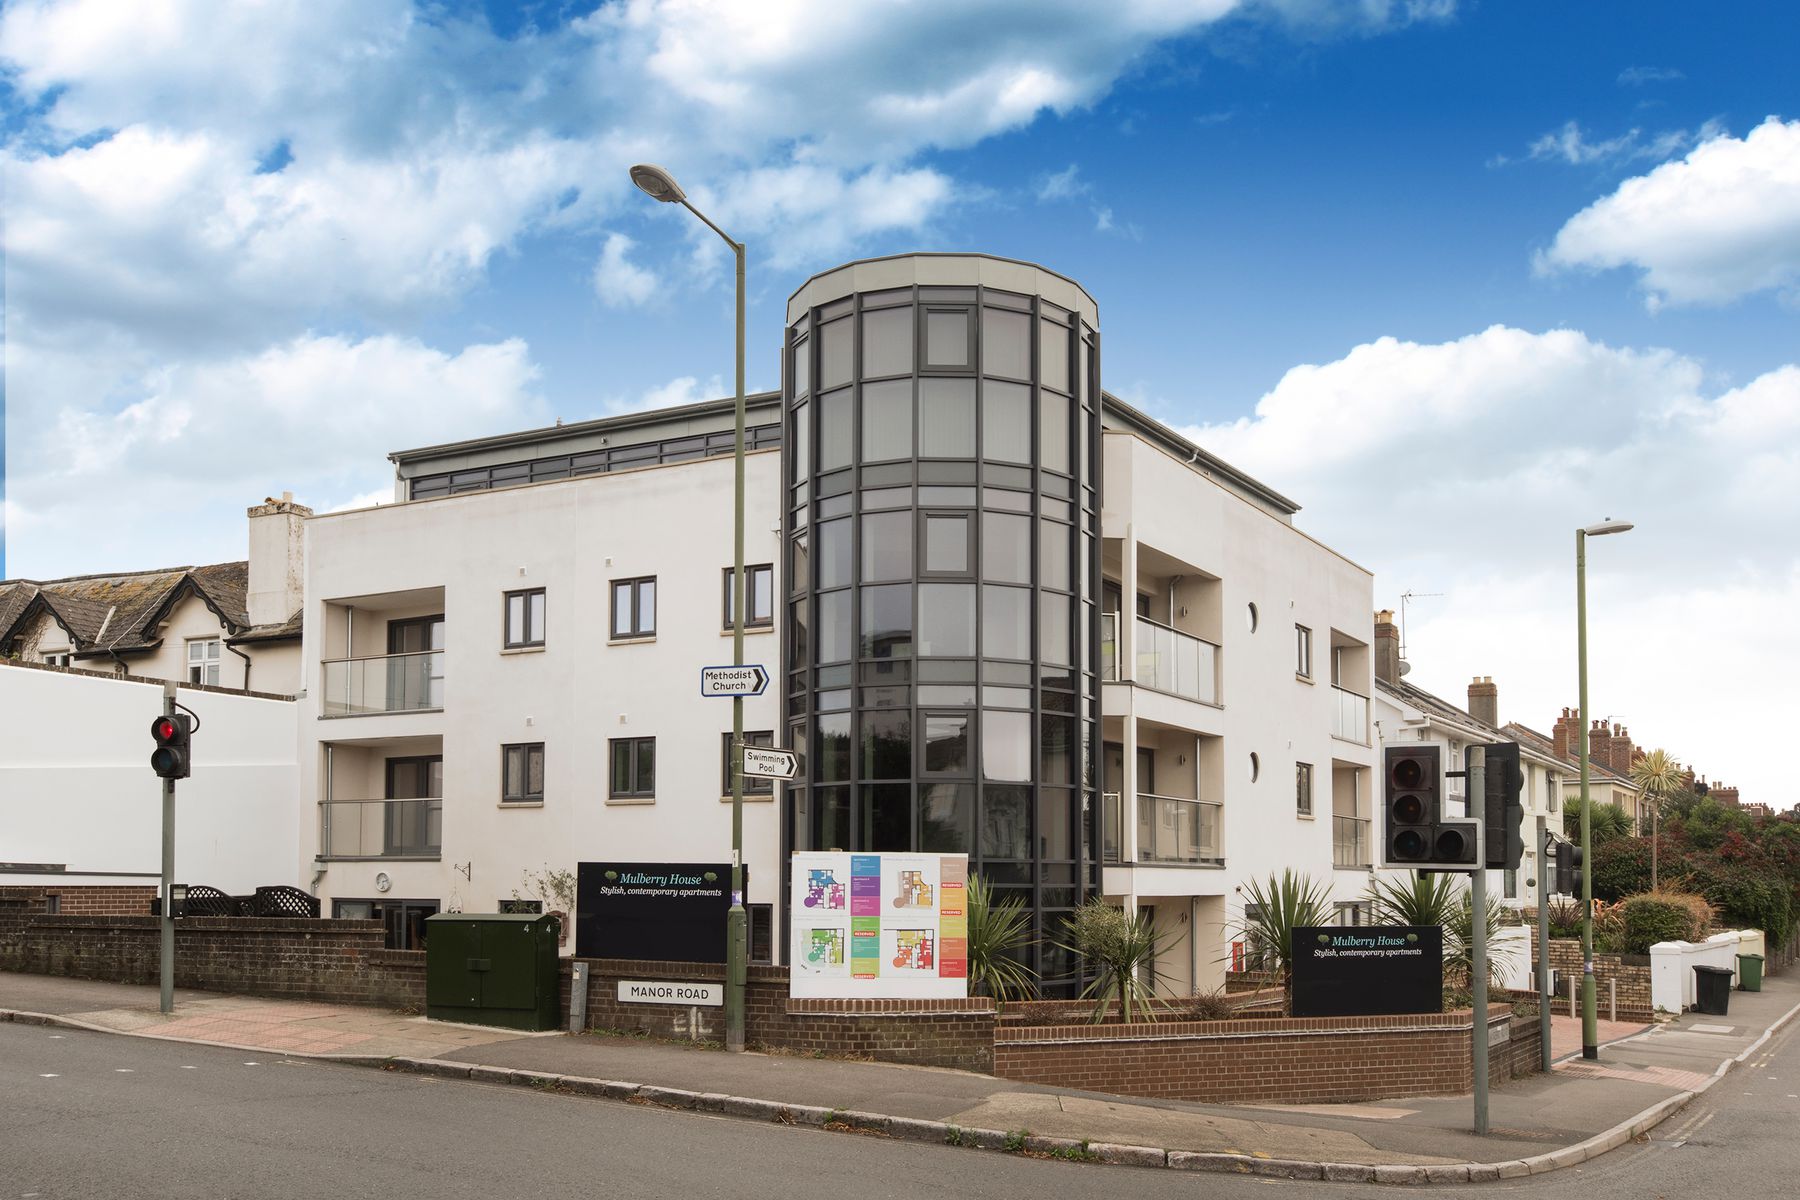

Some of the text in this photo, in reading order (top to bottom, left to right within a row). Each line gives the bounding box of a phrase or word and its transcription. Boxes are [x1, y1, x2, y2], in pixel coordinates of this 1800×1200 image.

[705, 670, 752, 680] Methodist
[712, 681, 746, 691] Church
[747, 751, 785, 765] Swimming
[759, 763, 775, 773] Pool
[619, 873, 702, 886] Mulberry House
[600, 886, 722, 897] Stylish, contemporary apartments
[1332, 935, 1405, 948] Mulberry House
[1314, 948, 1422, 958] Stylish, contemporary apartments
[631, 986, 709, 999] MANOR ROAD
